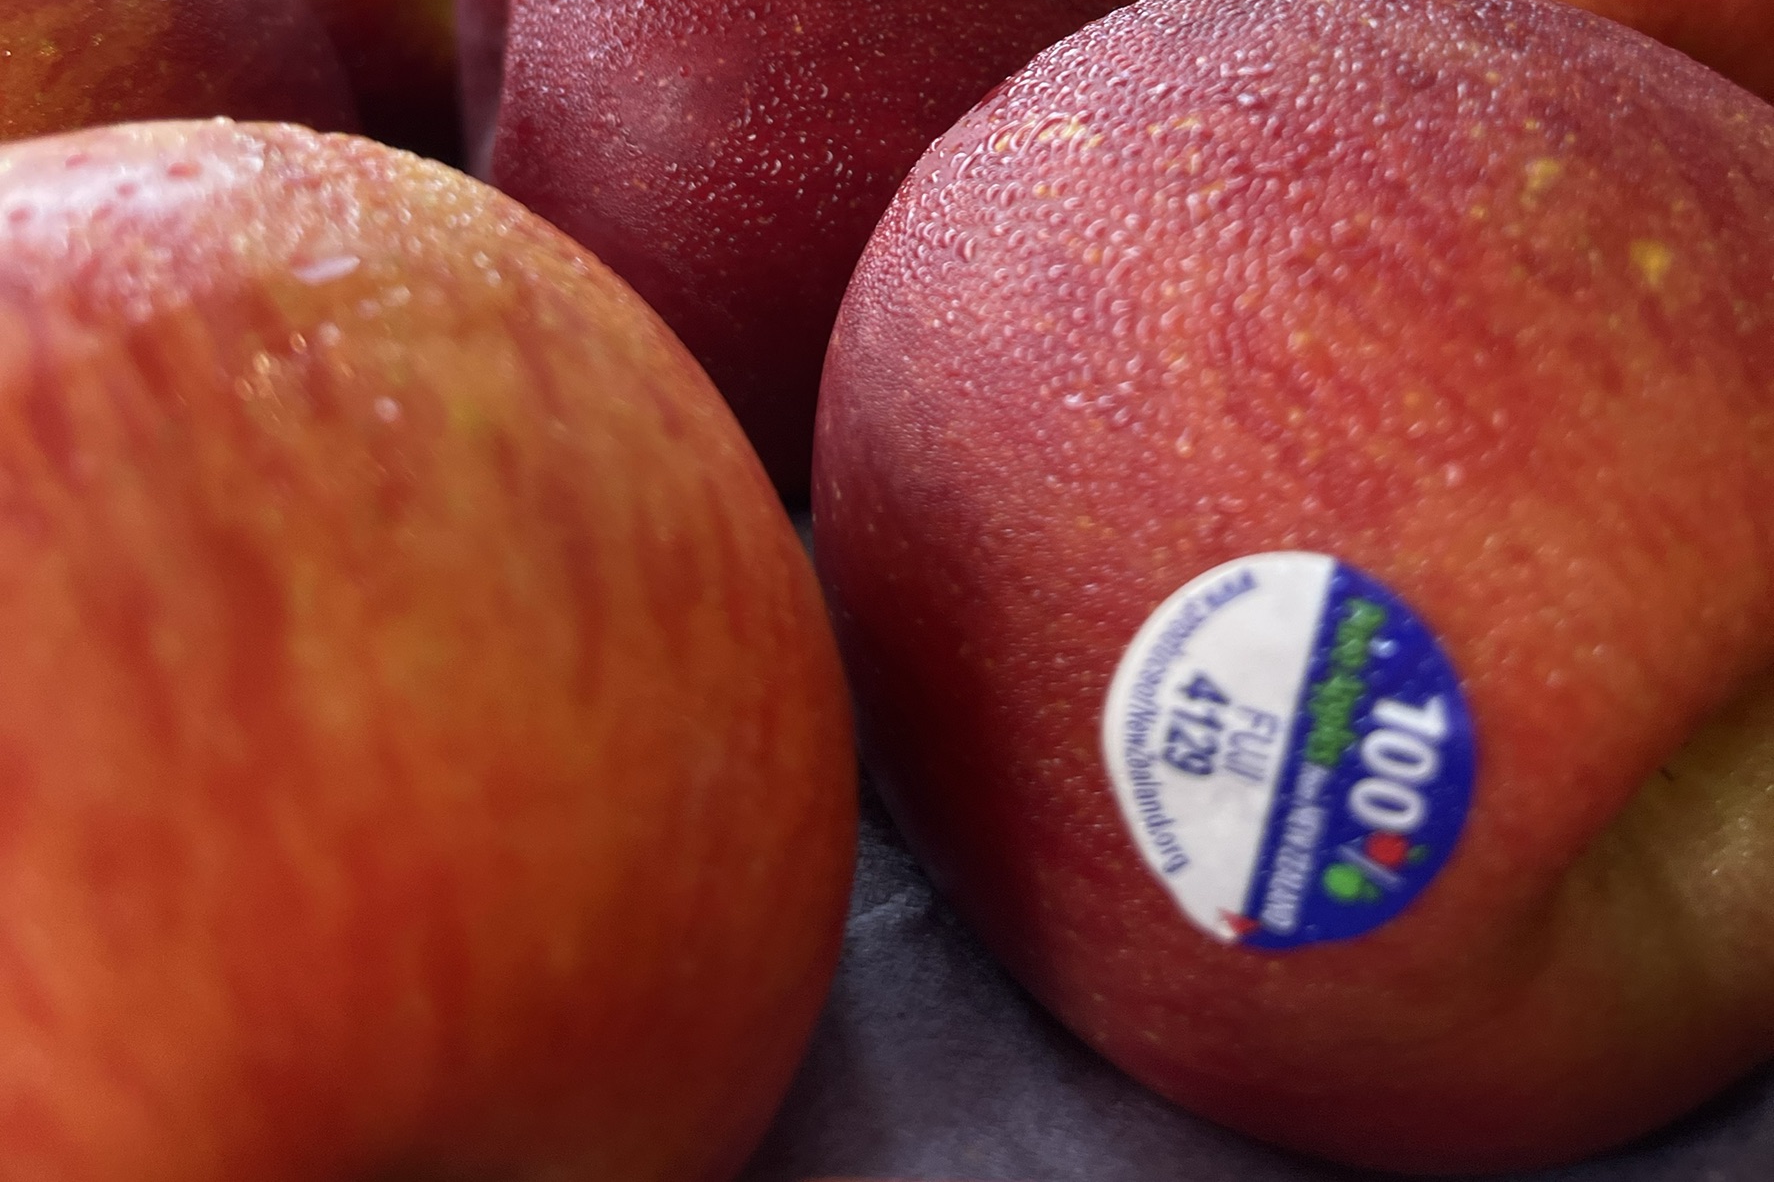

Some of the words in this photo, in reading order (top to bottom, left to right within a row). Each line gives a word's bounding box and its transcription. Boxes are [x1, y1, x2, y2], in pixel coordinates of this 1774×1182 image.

[1163, 671, 1230, 776] 4129
[1222, 704, 1280, 784] FUJI
[1261, 844, 1315, 934] ZEALAND
